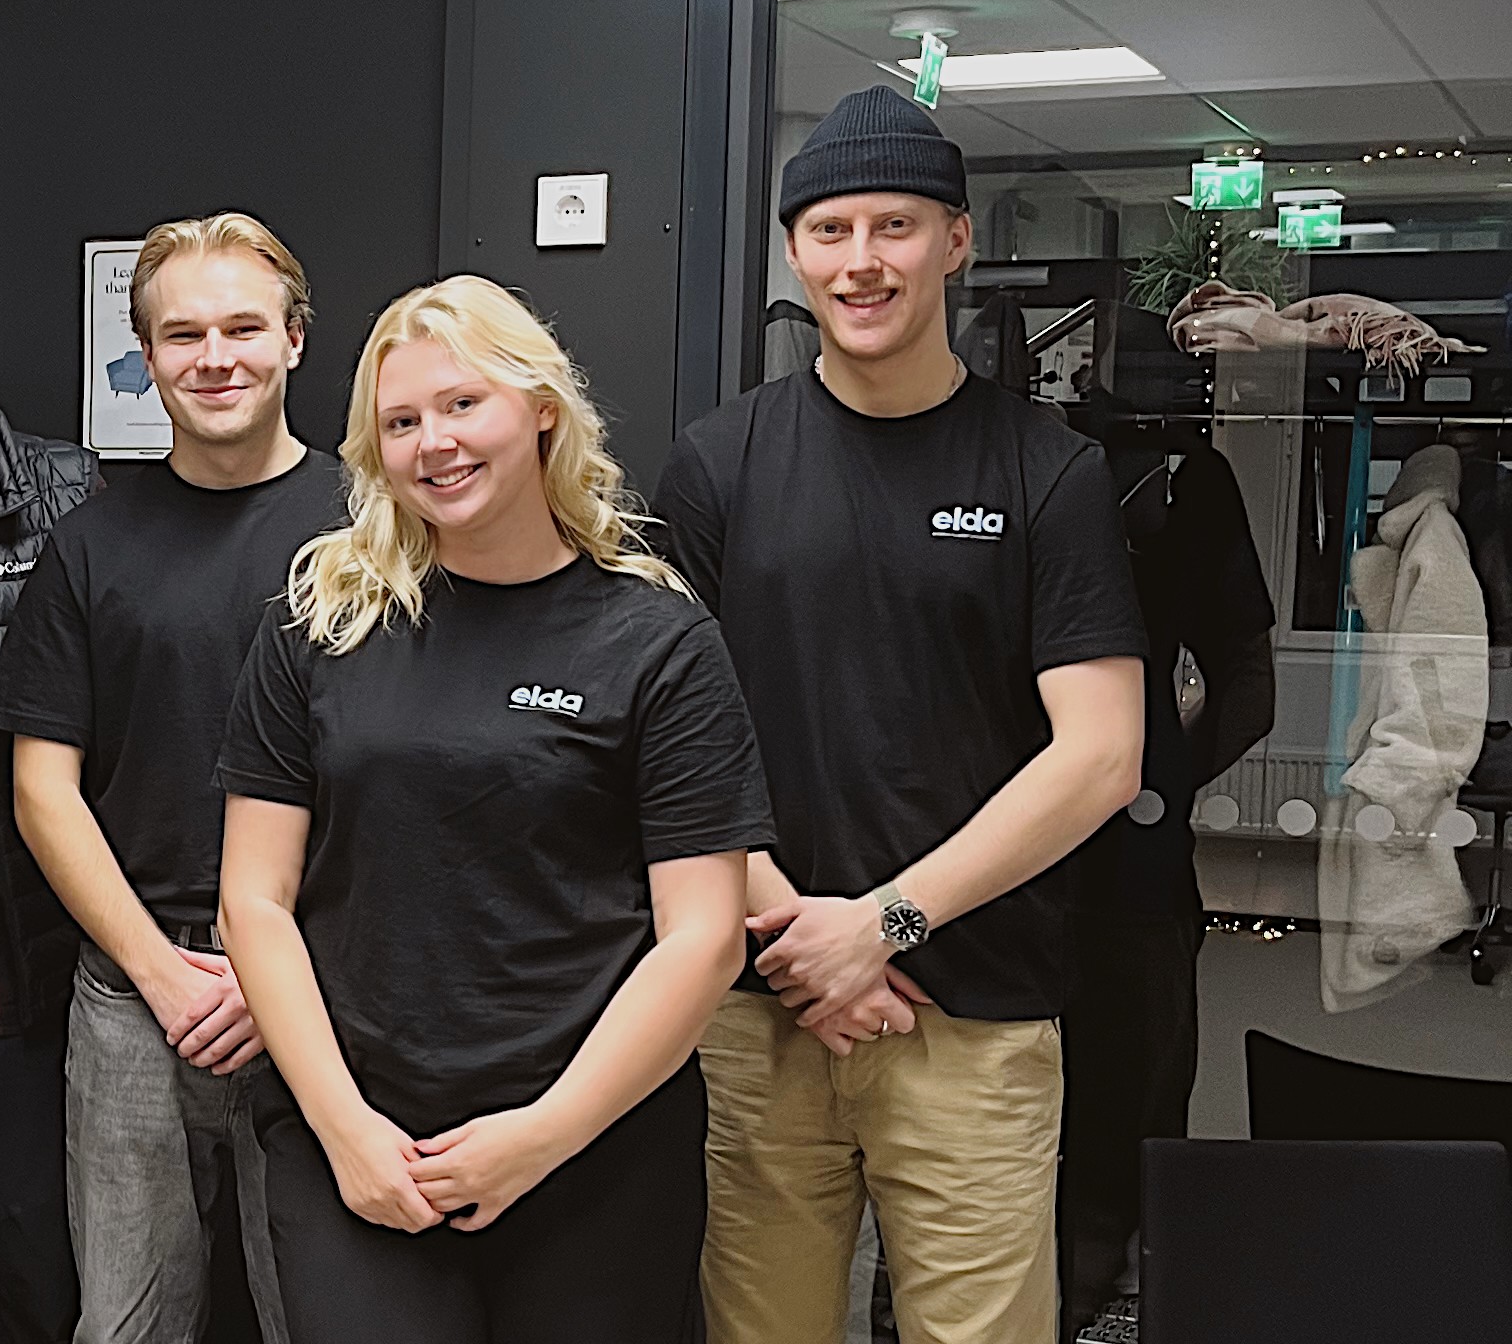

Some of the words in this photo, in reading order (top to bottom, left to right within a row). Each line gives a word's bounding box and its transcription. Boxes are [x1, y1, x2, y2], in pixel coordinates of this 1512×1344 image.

[113, 266, 135, 278] Lea
[931, 506, 1004, 534] elda
[4, 557, 37, 574] Colum
[510, 685, 584, 713] elda
